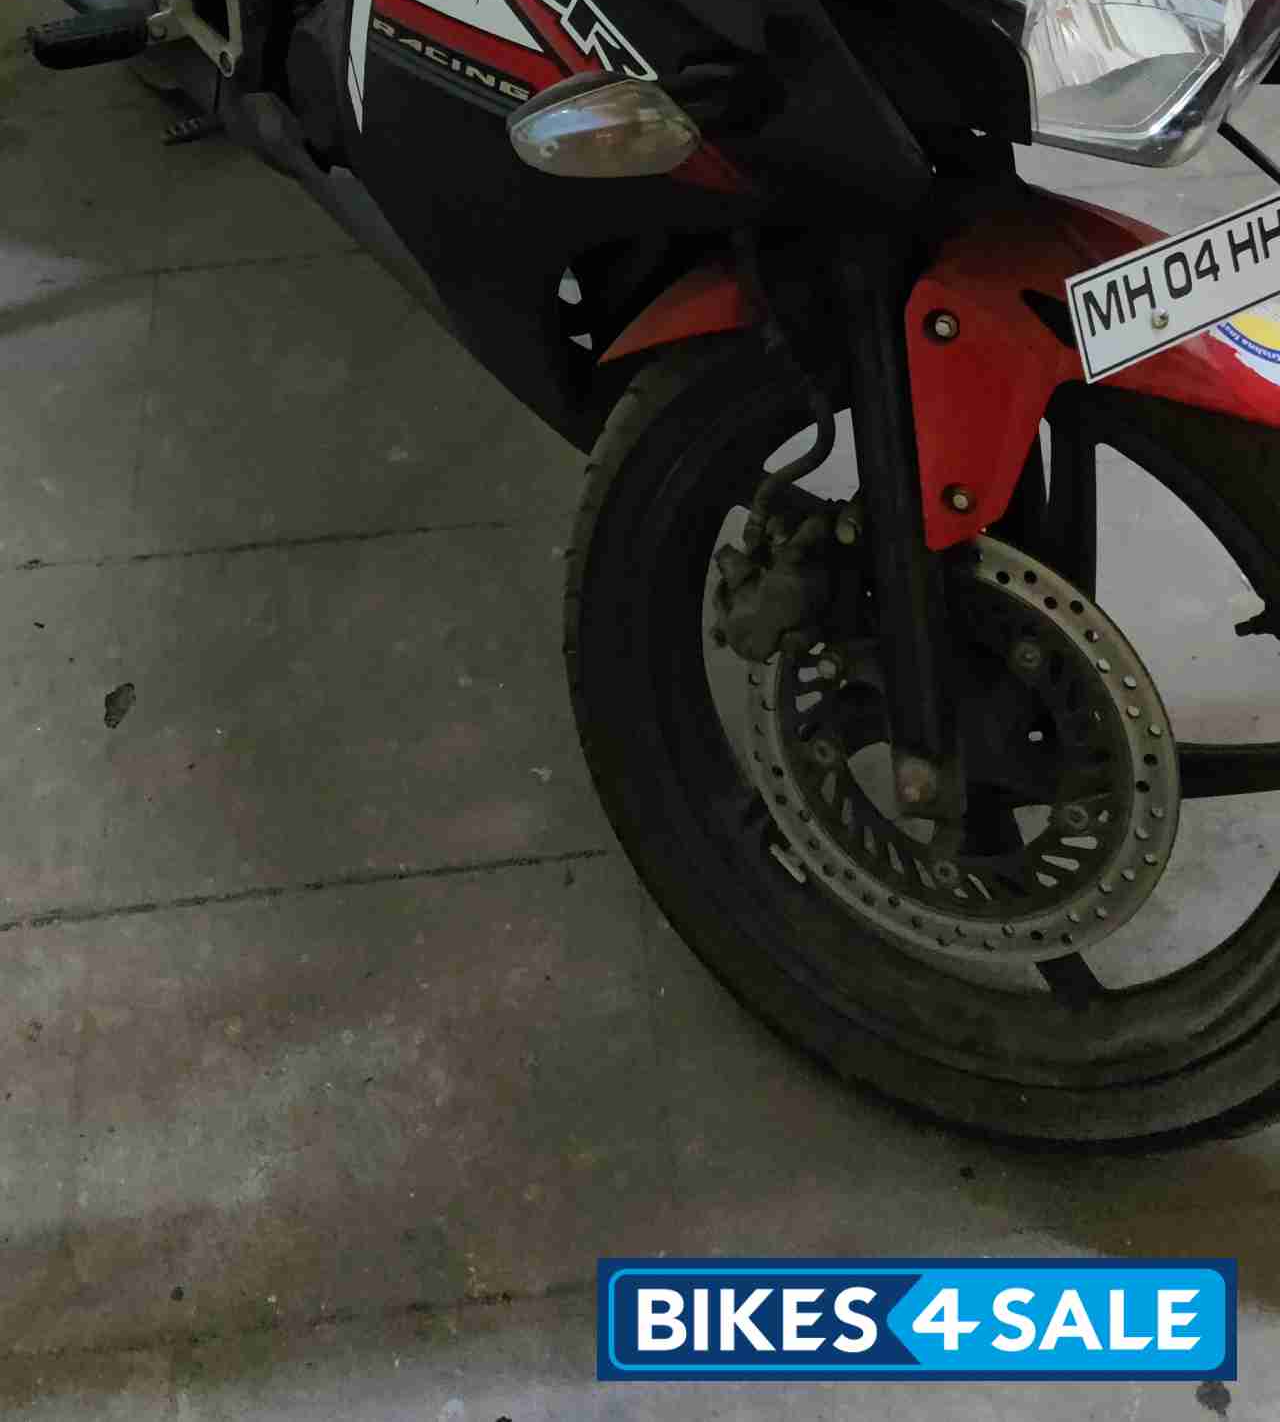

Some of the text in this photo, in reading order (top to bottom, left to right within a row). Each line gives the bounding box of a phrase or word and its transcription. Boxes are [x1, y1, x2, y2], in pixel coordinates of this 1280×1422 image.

[373, 17, 530, 101] RACING
[1083, 266, 1157, 337] MH
[1164, 239, 1221, 300] 04
